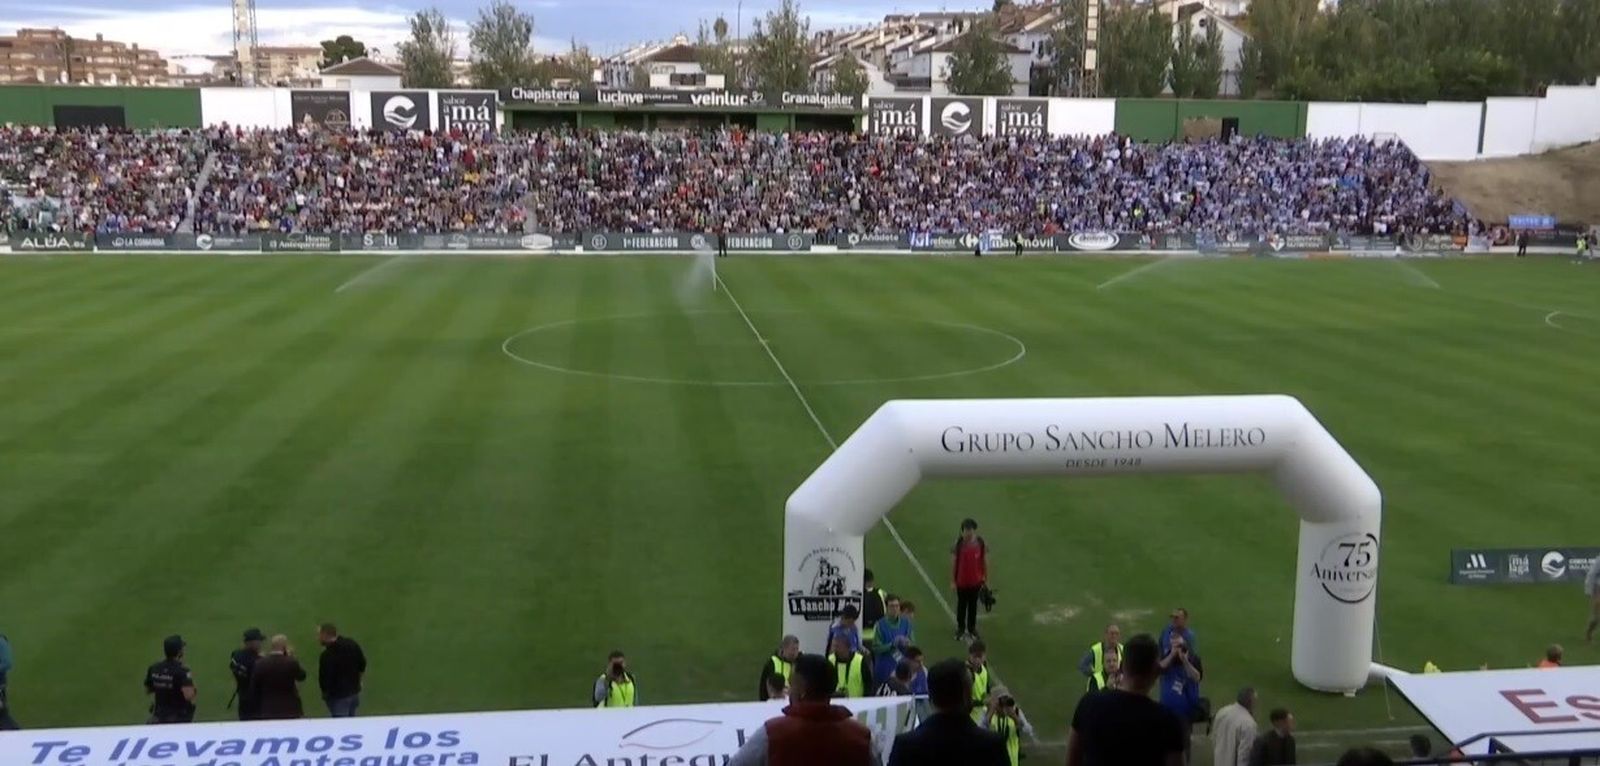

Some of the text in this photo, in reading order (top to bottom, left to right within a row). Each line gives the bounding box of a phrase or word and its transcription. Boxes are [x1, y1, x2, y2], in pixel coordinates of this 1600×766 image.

[512, 87, 580, 103] Chapistería
[782, 92, 853, 108] Granalquiler
[1065, 457, 1142, 468] DESDE 1948
[1338, 541, 1371, 567] 75
[801, 598, 835, 612] Sancho
[31, 727, 460, 764] Te llevamos los
